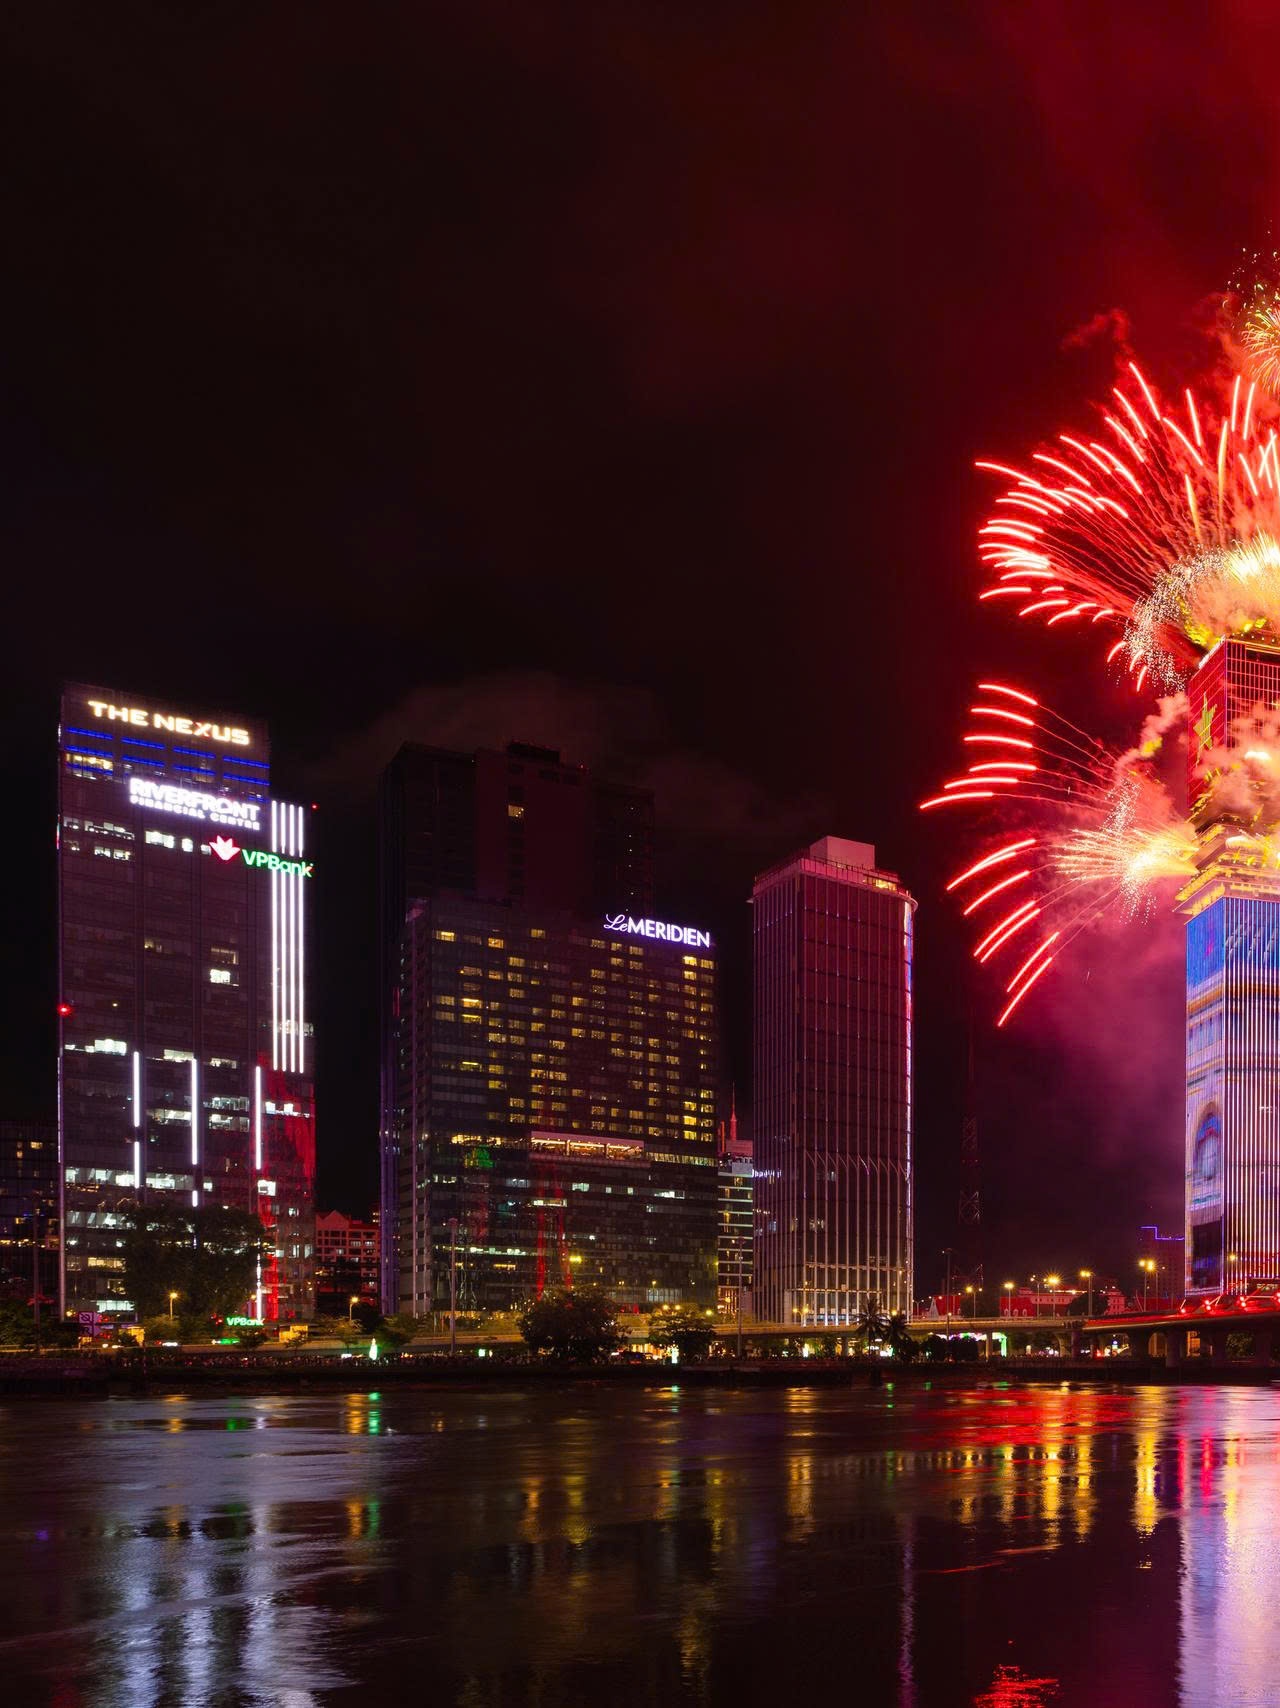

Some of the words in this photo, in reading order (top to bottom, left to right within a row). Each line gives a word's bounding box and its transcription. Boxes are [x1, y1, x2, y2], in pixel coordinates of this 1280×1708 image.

[88, 700, 149, 726] THE
[154, 714, 250, 745] NEXUS
[130, 777, 260, 821] RIVERFRONT
[242, 848, 314, 878] VPBank
[227, 1316, 265, 1326] VPBank
